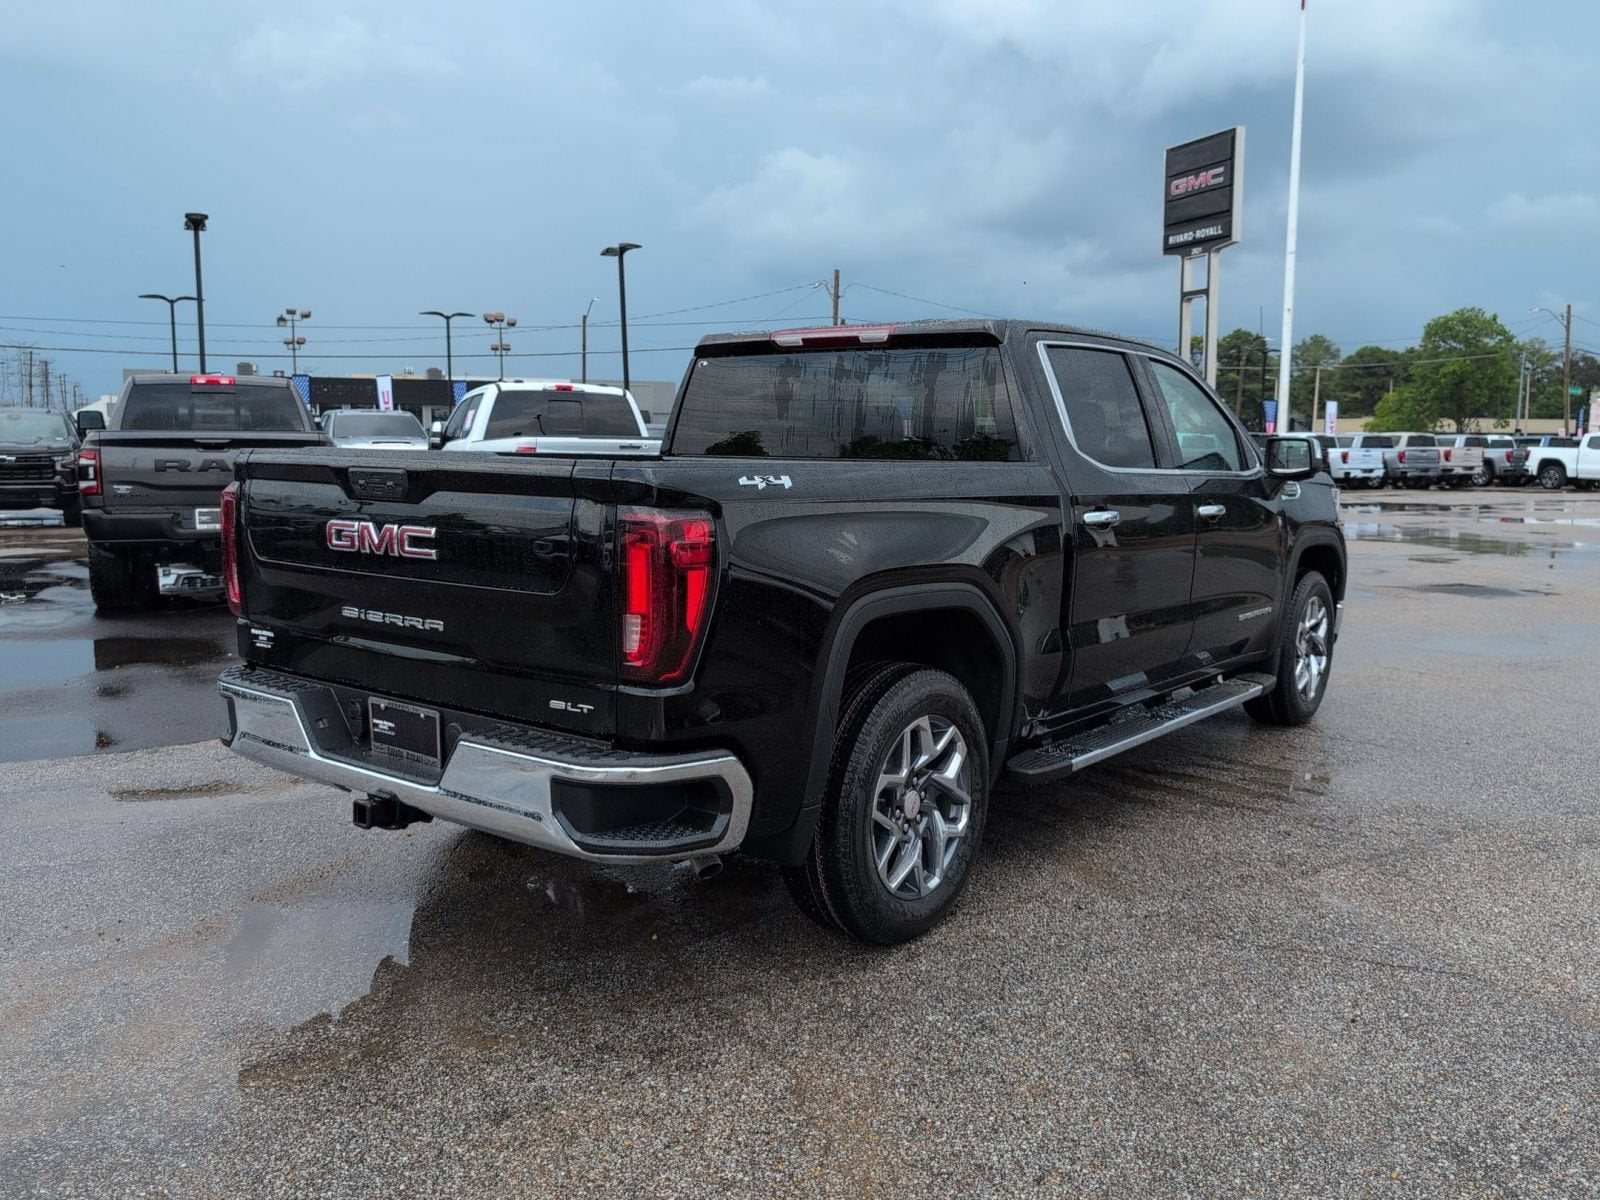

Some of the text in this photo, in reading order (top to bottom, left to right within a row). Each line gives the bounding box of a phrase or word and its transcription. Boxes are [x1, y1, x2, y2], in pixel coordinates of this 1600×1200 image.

[1170, 166, 1225, 196] GMC
[154, 459, 233, 472] RA
[326, 520, 437, 560] GMC
[341, 606, 444, 631] SIERRA
[549, 700, 595, 714] SLT
